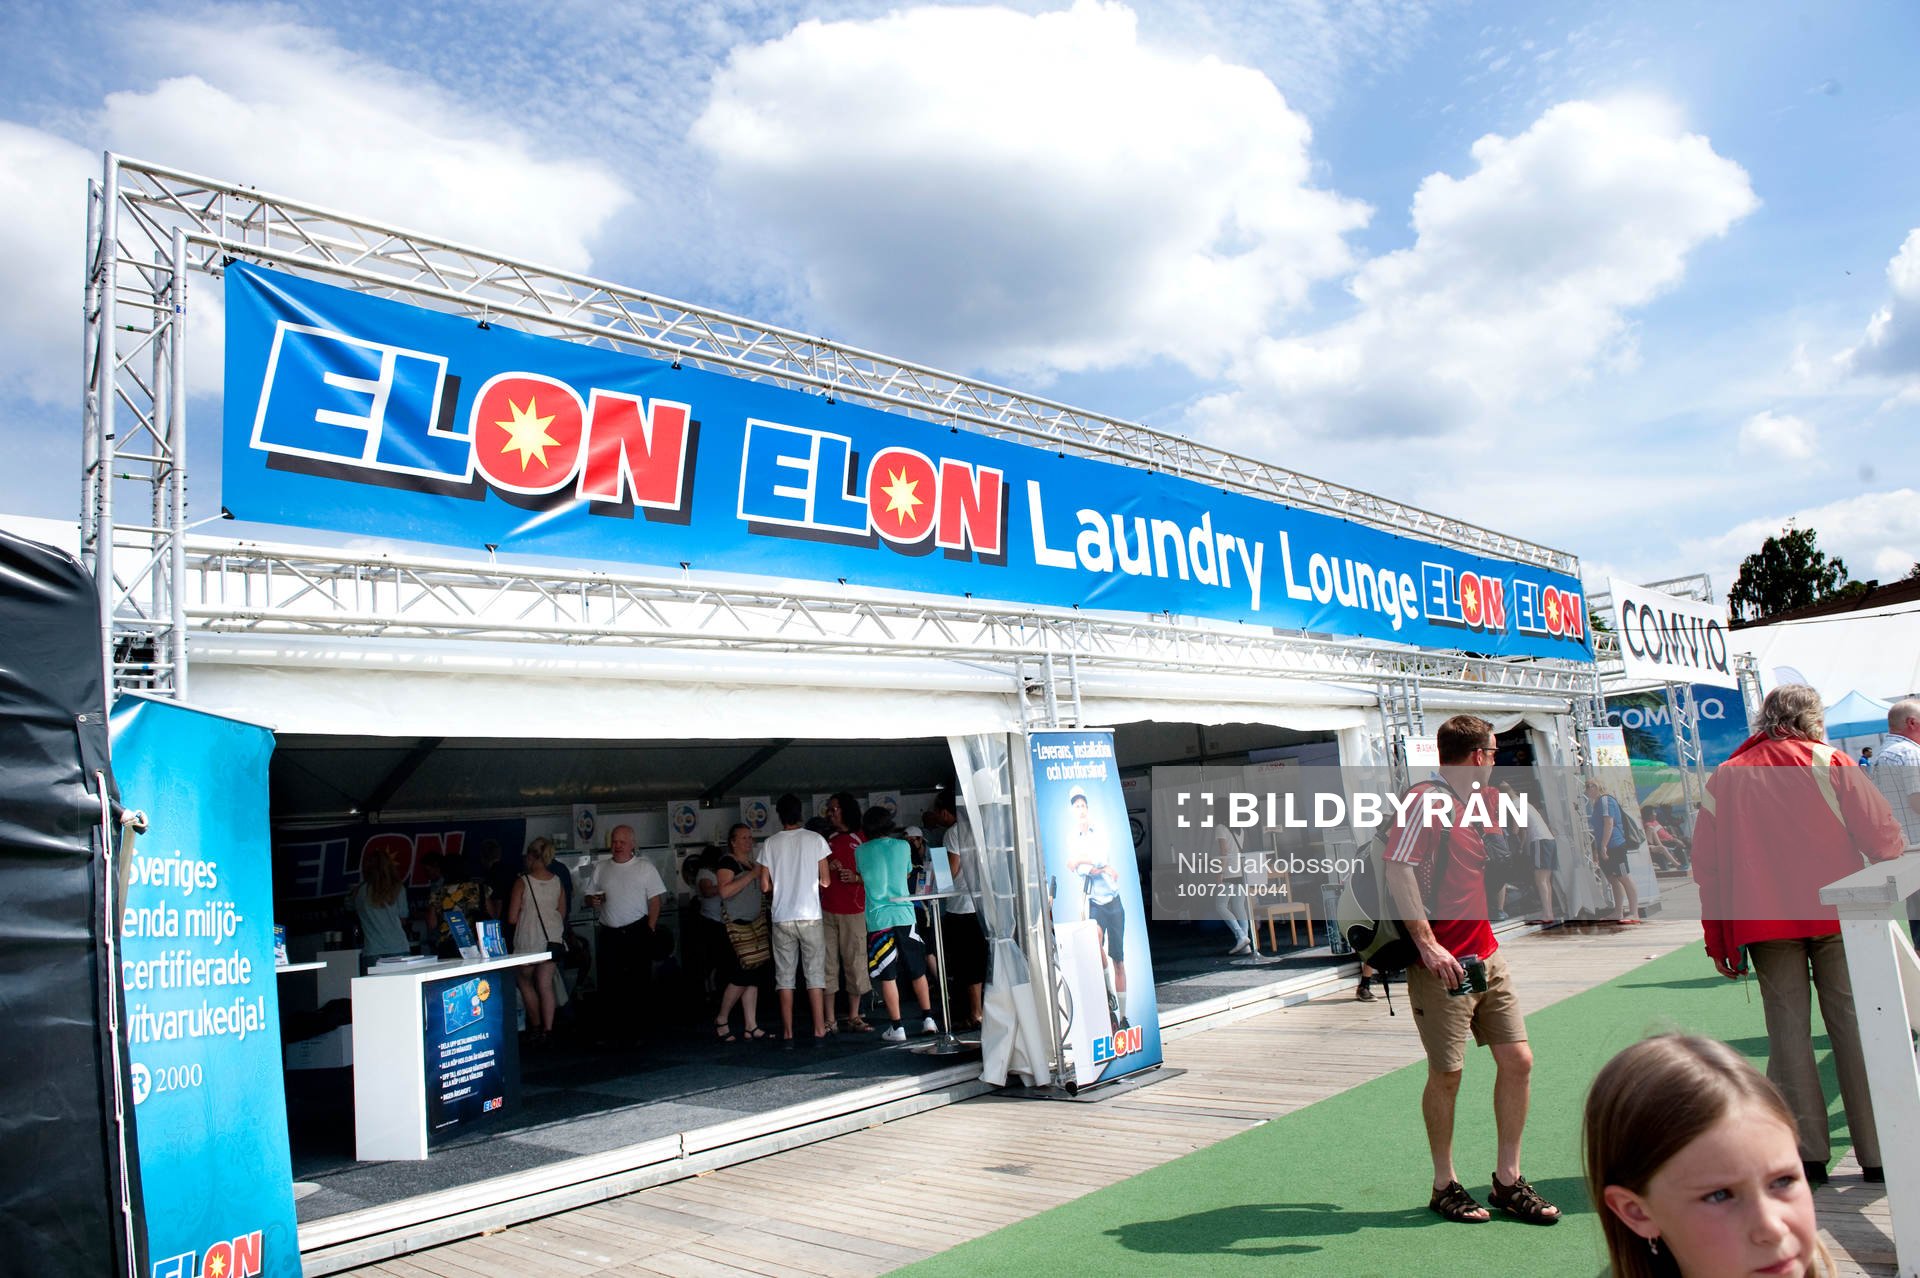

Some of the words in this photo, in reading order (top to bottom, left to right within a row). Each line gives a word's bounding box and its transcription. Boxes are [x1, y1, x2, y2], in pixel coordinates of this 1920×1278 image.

[250, 319, 692, 512] ELON
[737, 417, 1004, 556] ELON
[1027, 479, 1264, 611] Laundry
[1279, 530, 1419, 631] Lounge
[1422, 561, 1505, 630] ELON
[1513, 579, 1584, 640] ELON
[1623, 599, 1730, 676] COMVIQ
[1606, 698, 1726, 730] COMIQ
[122, 900, 179, 937] enda
[185, 901, 243, 945] miljö-
[122, 949, 252, 991] certifierade
[1093, 1026, 1141, 1064] ELON
[155, 1063, 203, 1093] 2000
[483, 1096, 503, 1113] ELON
